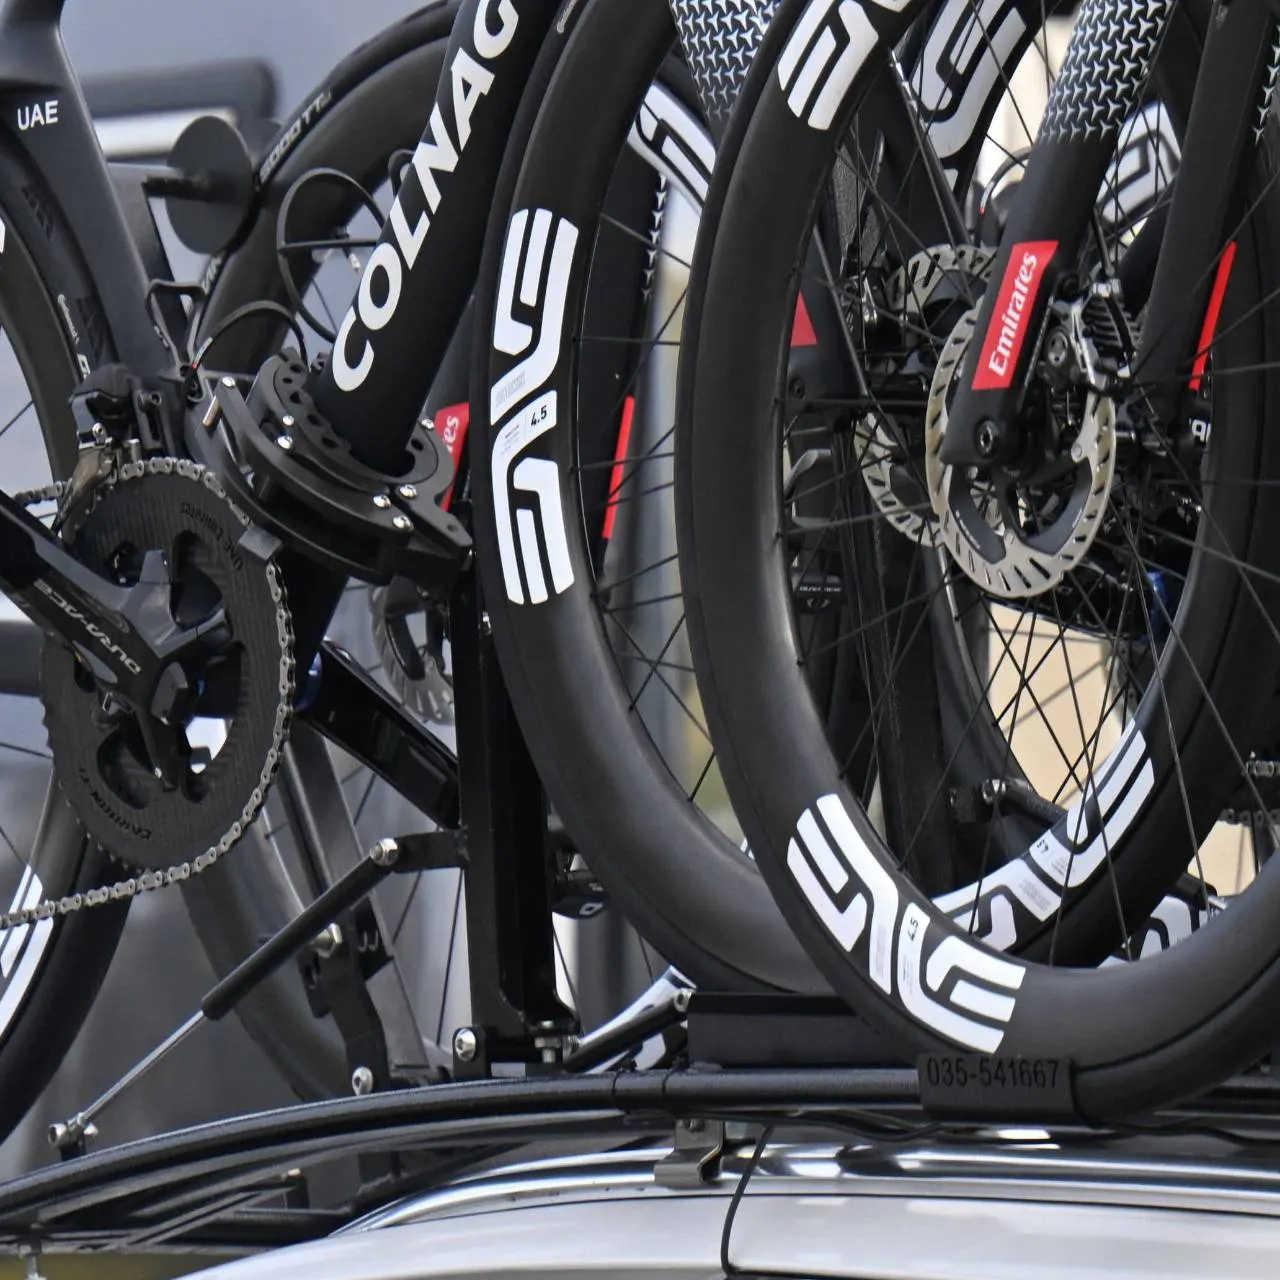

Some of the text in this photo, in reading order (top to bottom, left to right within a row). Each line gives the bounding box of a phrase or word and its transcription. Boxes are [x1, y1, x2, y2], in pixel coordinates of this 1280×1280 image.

[17, 100, 58, 130] UAE
[988, 252, 1038, 378] Emirates
[33, 578, 141, 675] DURA-ACE
[927, 1057, 1059, 1088] 035-541667
